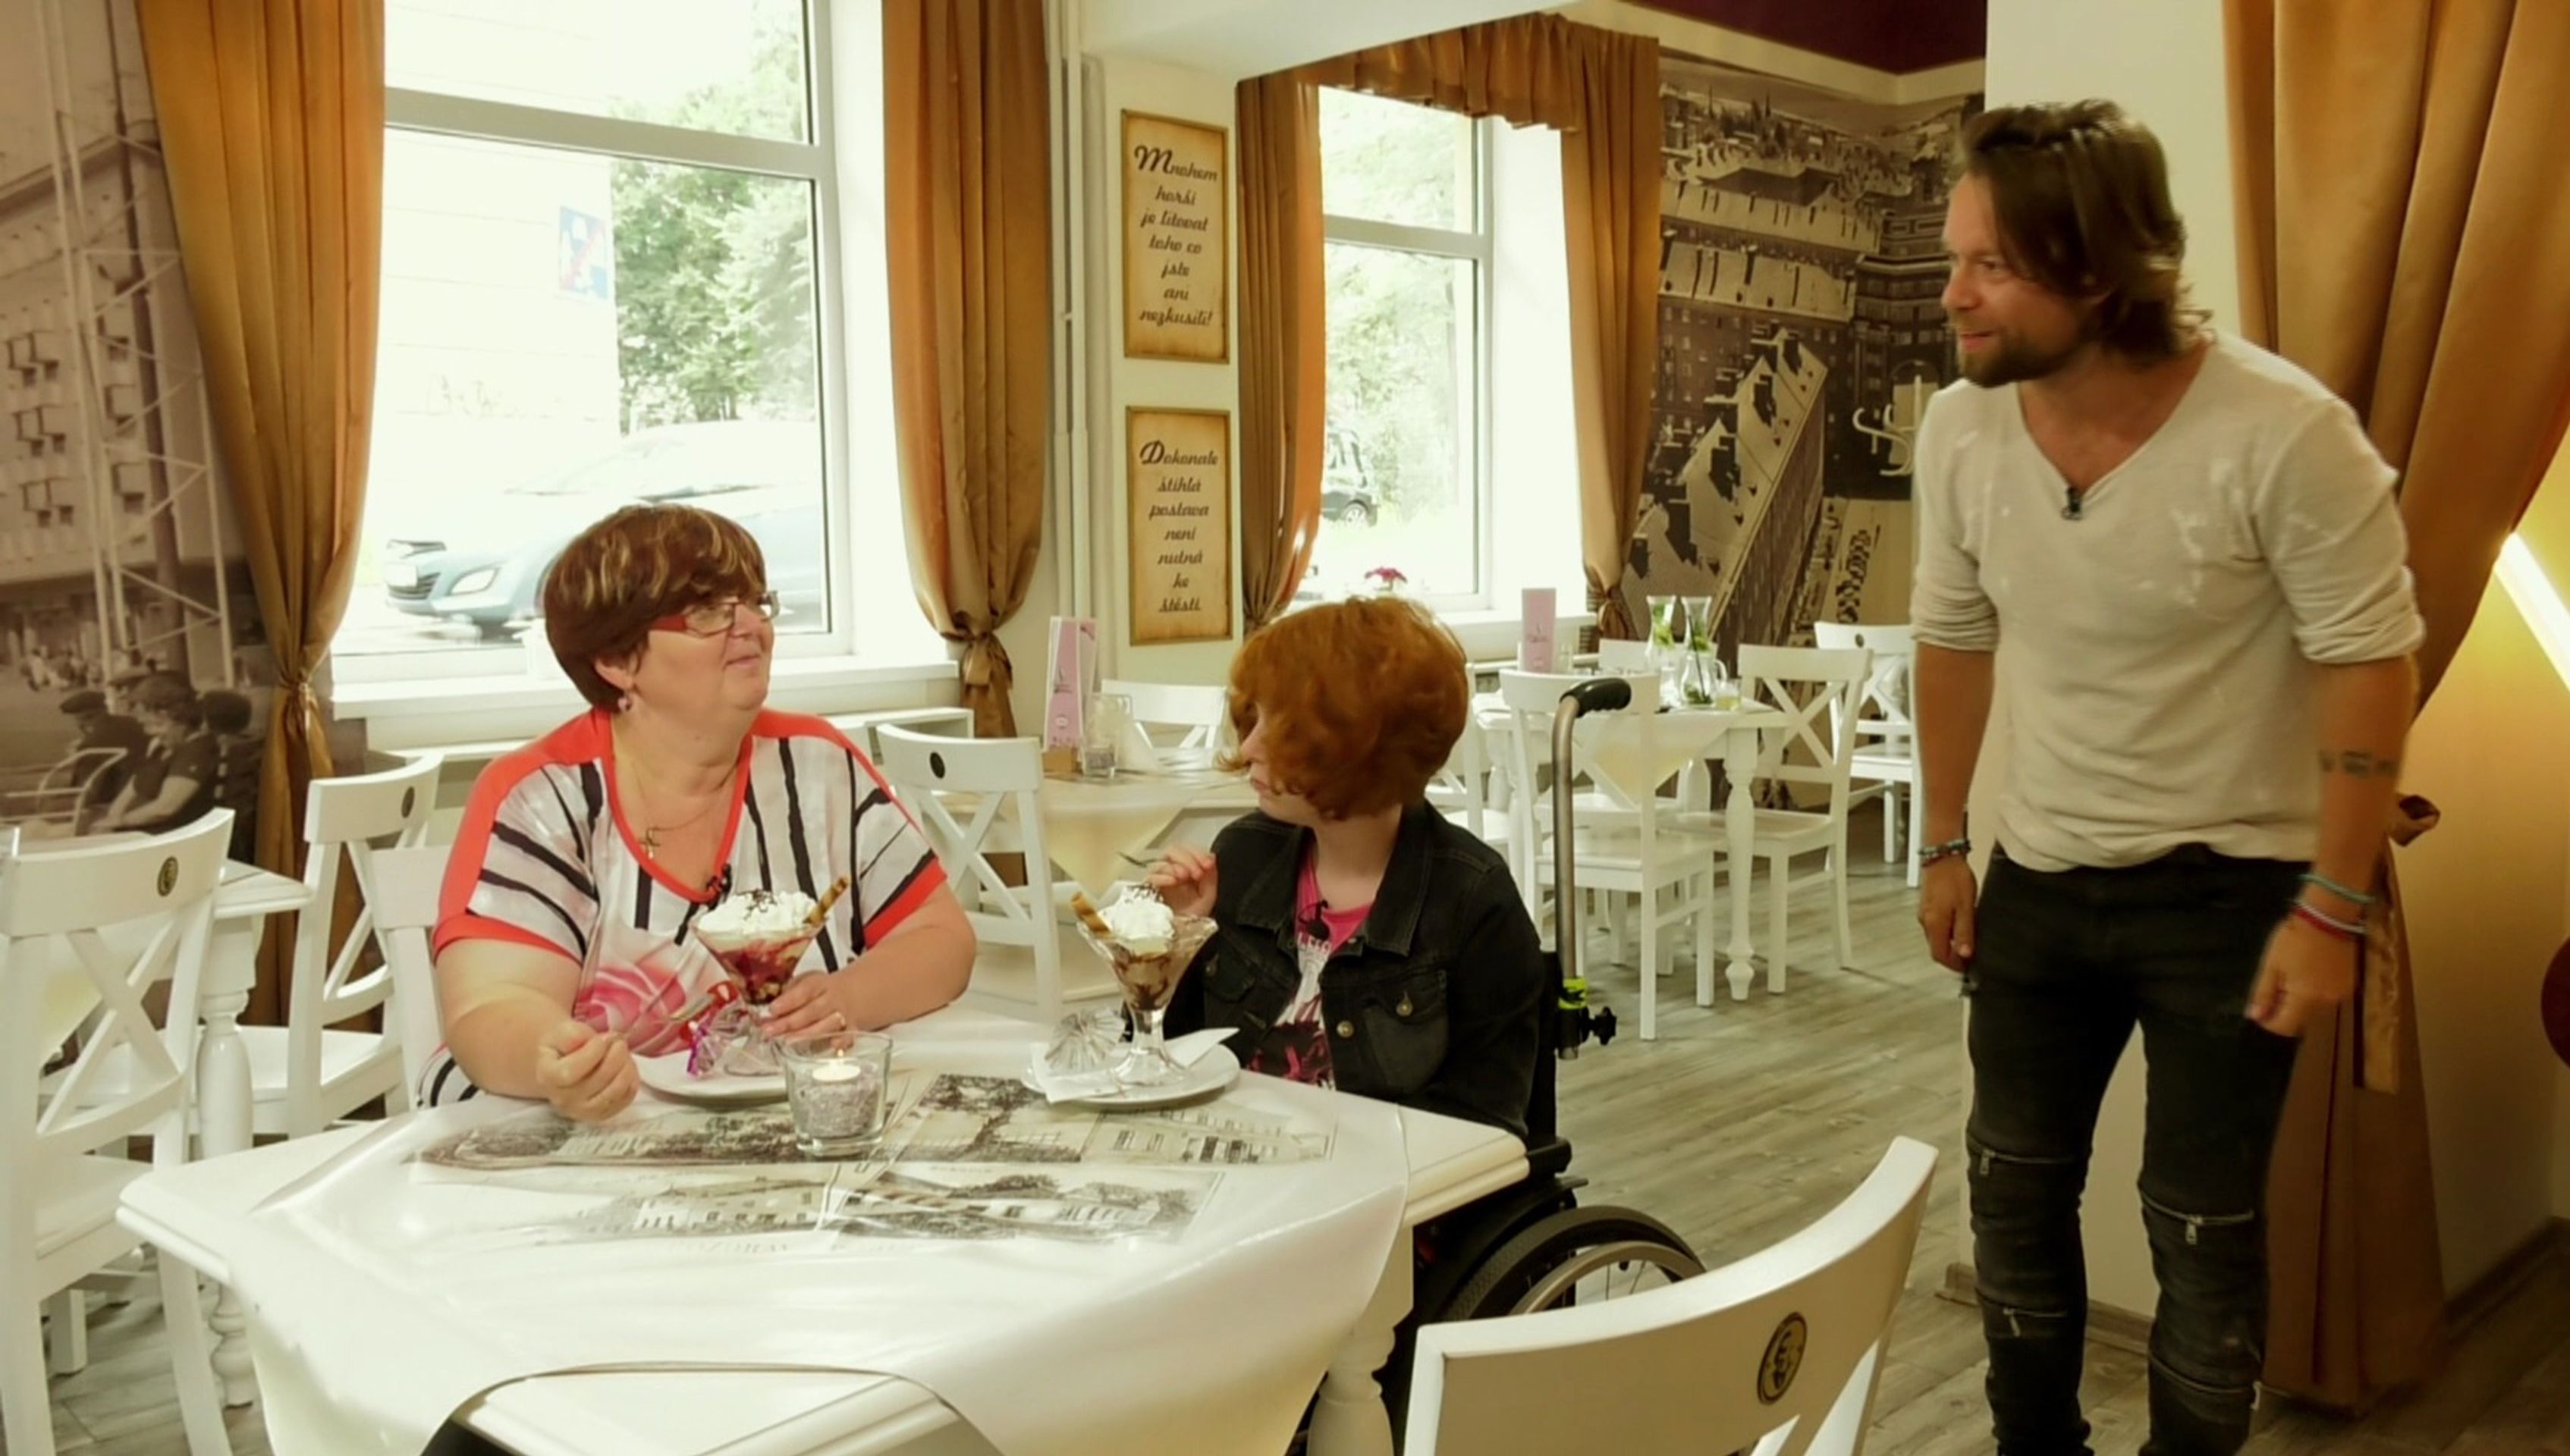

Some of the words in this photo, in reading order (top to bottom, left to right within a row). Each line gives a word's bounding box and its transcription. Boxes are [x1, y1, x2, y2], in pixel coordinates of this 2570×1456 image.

[1134, 145, 1217, 181] Mnohem
[1140, 207, 1156, 228] je
[1160, 210, 1208, 231] litovat
[1149, 234, 1183, 252] toho
[1186, 243, 1202, 254] co
[1161, 260, 1190, 279] jste
[1164, 288, 1189, 301] ani
[1139, 440, 1218, 465] Dokonale
[1148, 501, 1210, 520] postava
[1173, 573, 1189, 588] ke
